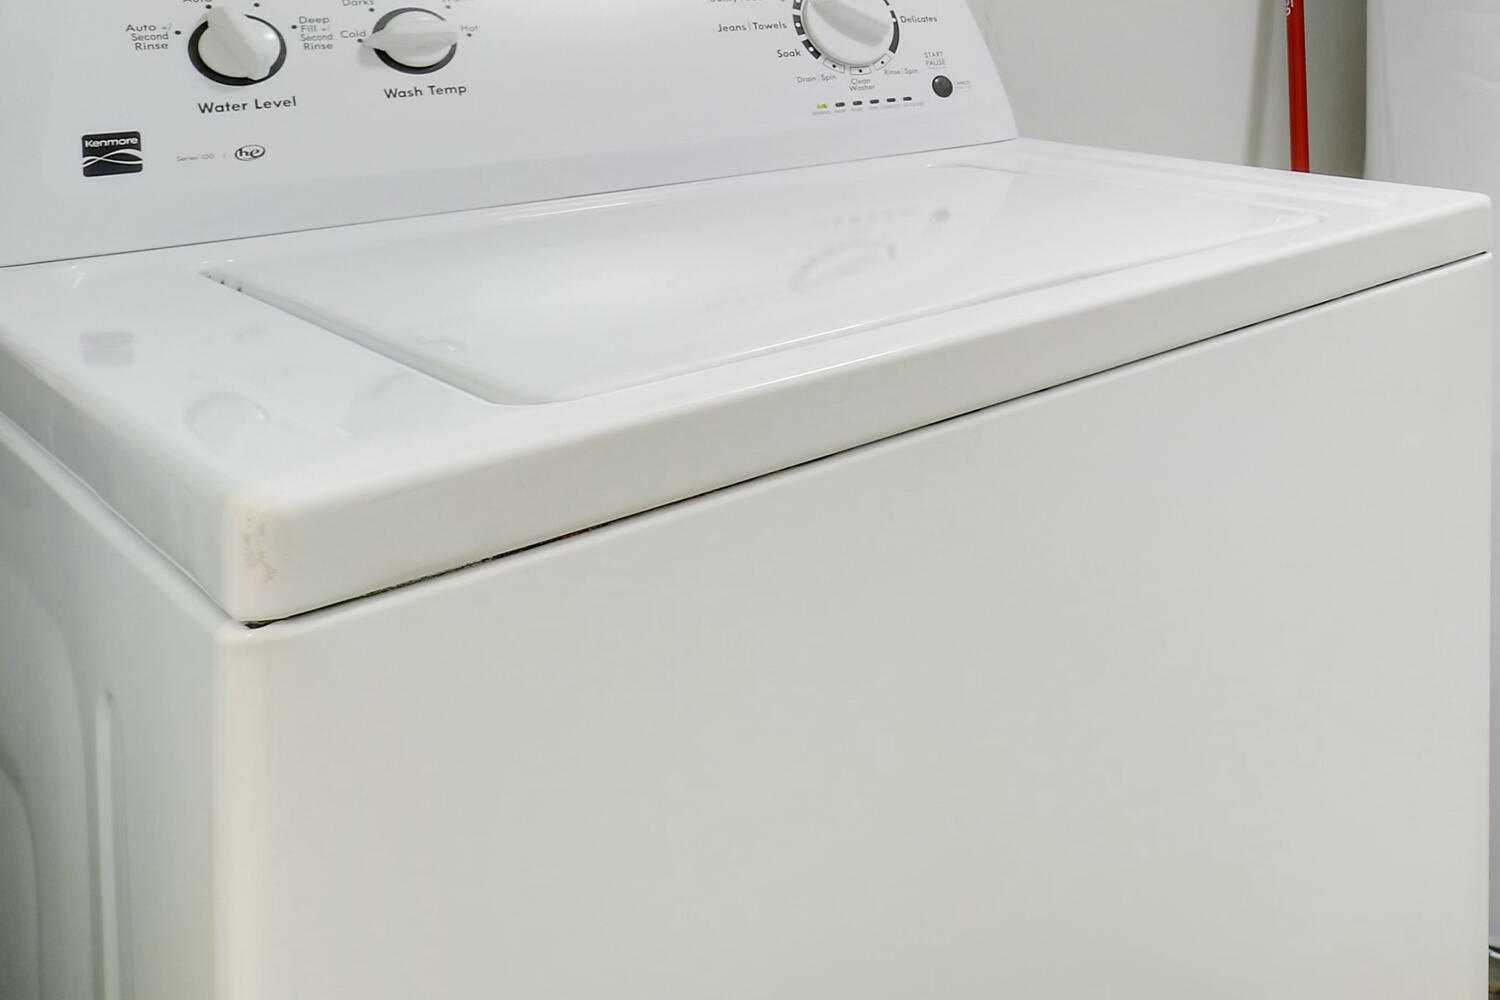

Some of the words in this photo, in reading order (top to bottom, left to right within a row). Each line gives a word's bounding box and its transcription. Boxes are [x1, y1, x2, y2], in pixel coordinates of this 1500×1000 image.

[298, 16, 330, 25] Deep
[900, 14, 938, 24] Delicates
[125, 24, 157, 32] Auto
[300, 24, 317, 33] Fill
[460, 25, 479, 33] Hot
[717, 22, 748, 33] Jeans
[752, 20, 788, 31] Towels
[131, 32, 169, 42] Second
[300, 33, 334, 42] Second
[340, 29, 367, 39] Cold
[135, 42, 169, 51] Rinse
[303, 42, 334, 51] Rinse
[776, 48, 801, 58] Soak
[923, 51, 944, 59] START
[925, 58, 947, 67] PAUSE
[904, 67, 919, 76] Spin
[796, 75, 817, 84] Drain
[820, 74, 837, 83] Spin
[850, 77, 872, 86] Clean
[383, 87, 424, 99] Wash
[427, 85, 467, 96] Temp
[849, 84, 876, 93] Washer
[198, 100, 249, 115] Water
[255, 96, 298, 111] Level
[84, 136, 139, 149] Kenmore
